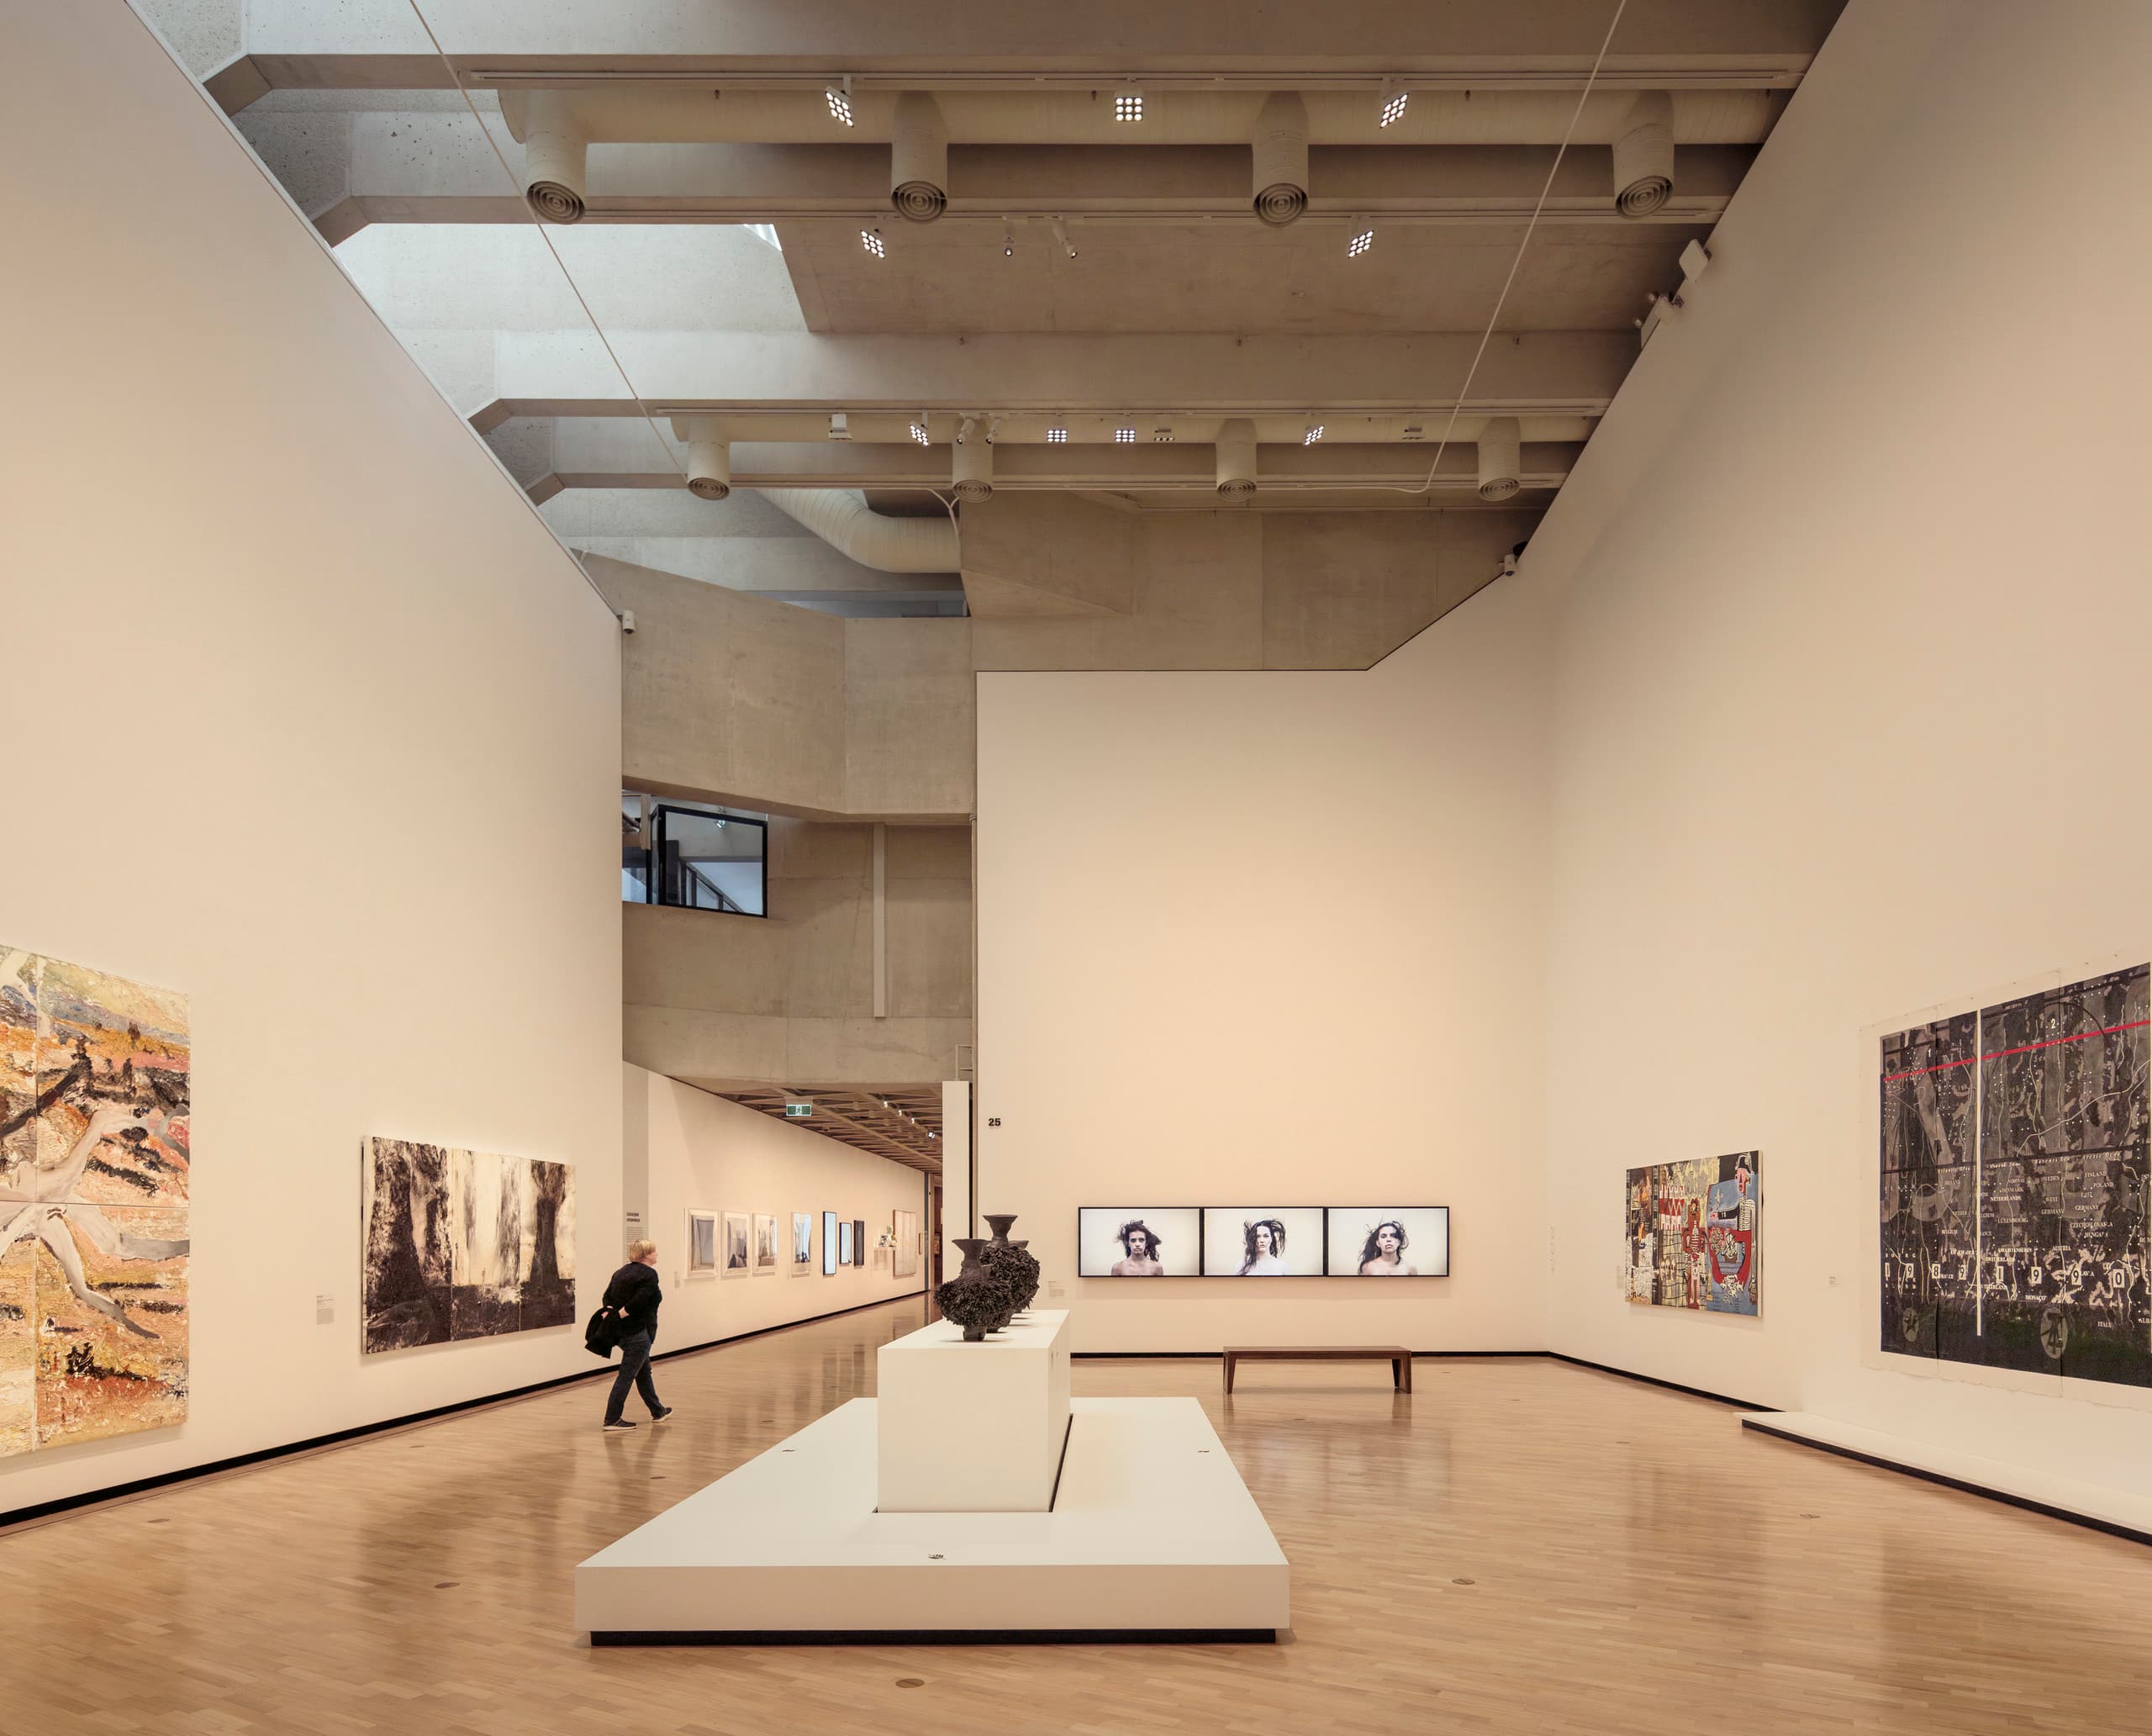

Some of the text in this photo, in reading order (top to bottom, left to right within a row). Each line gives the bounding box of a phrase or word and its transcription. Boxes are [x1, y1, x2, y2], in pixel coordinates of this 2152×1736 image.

[2050, 1018, 2056, 1029] 2
[988, 1117, 1001, 1127] 25
[2033, 1269, 2040, 1282] 9
[2072, 1270, 2080, 1283] 9
[2115, 1271, 2123, 1286] 0
